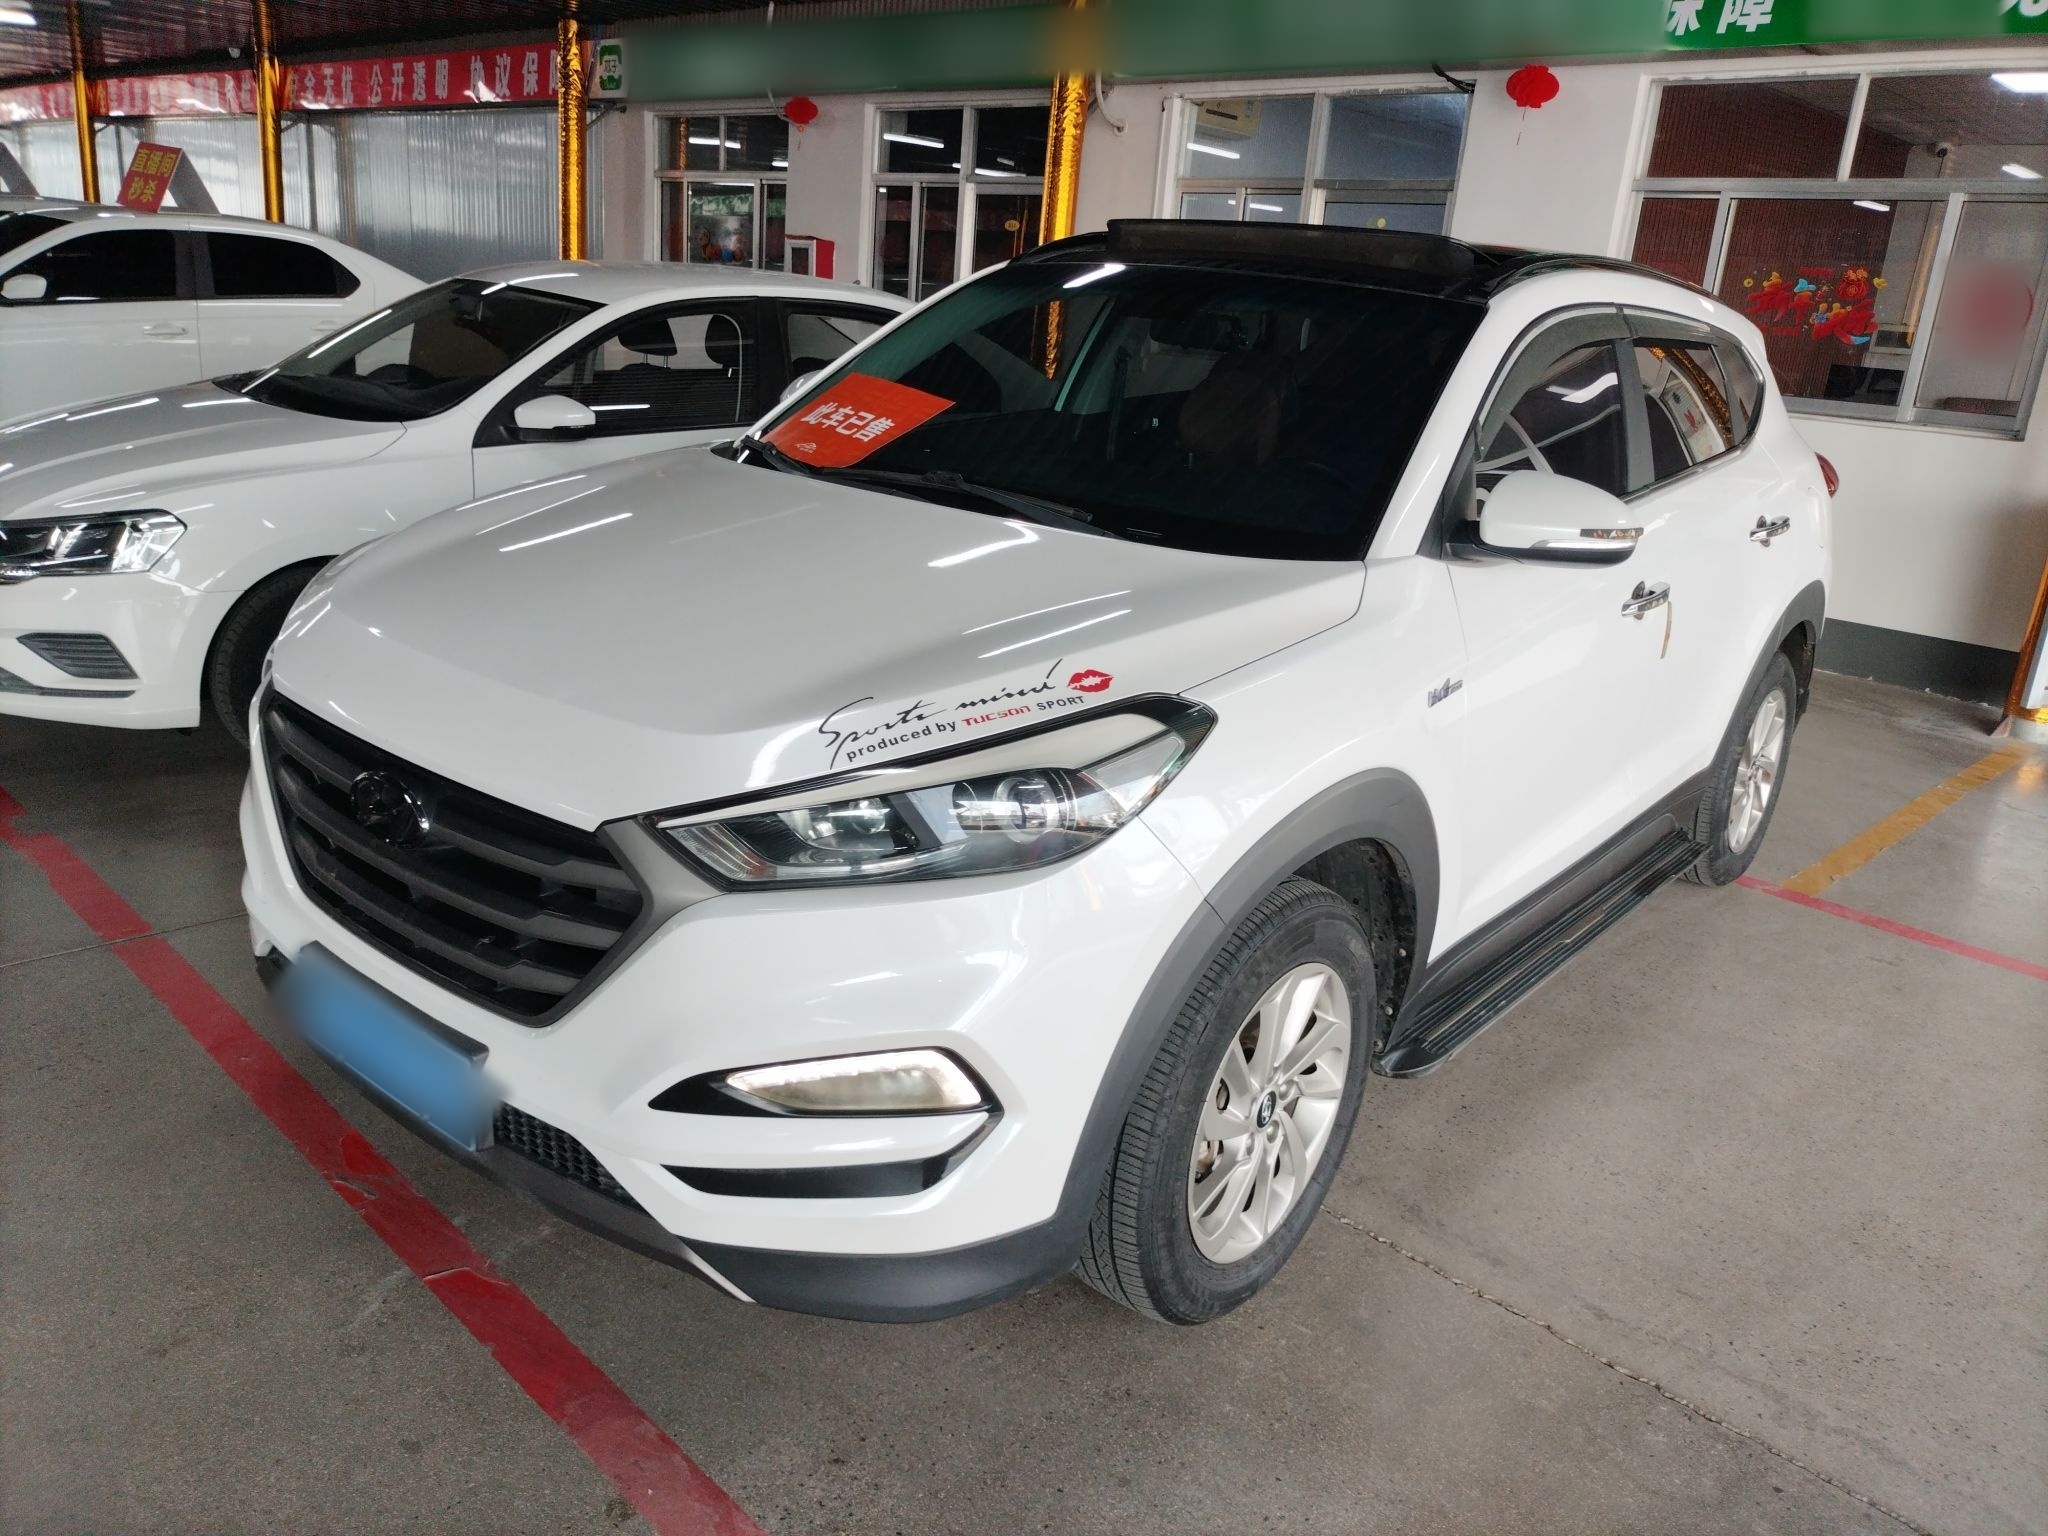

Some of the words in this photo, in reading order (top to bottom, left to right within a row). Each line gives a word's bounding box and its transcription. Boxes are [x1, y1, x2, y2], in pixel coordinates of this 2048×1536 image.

[370, 58, 449, 104] 公开透明
[131, 148, 176, 177] 直播间
[127, 176, 159, 203] 秒杀
[800, 401, 895, 442] 此车已售
[955, 658, 1063, 711] mind
[846, 726, 933, 762] produced
[935, 719, 957, 733] by
[1036, 695, 1086, 712] SPORT
